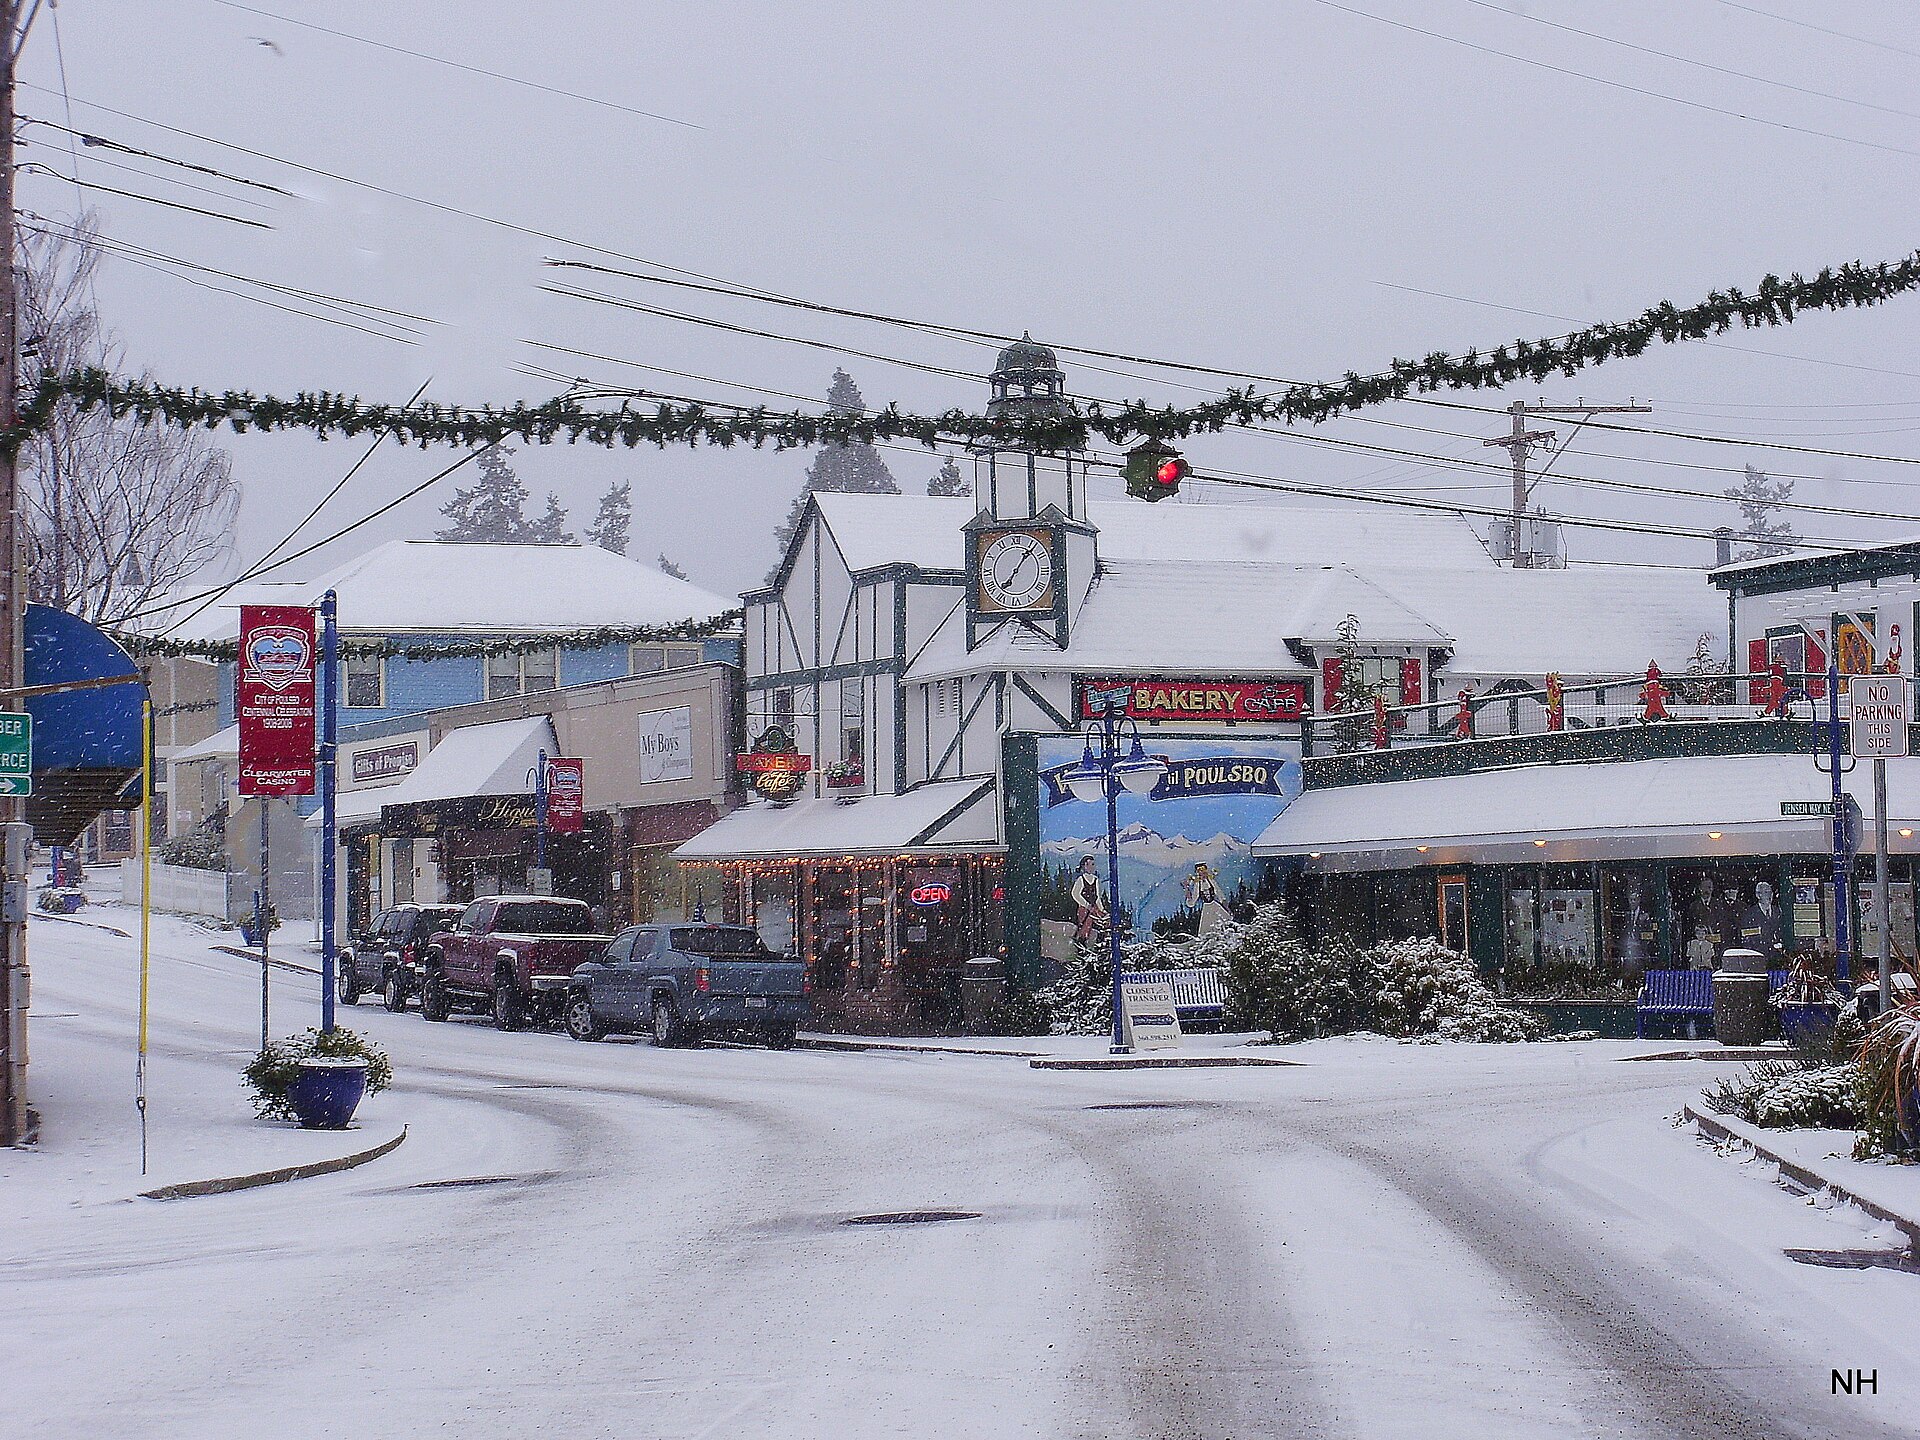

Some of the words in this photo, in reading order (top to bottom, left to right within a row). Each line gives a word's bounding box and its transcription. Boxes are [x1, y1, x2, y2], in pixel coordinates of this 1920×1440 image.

[1135, 689, 1241, 710] BAKERY
[1868, 687, 1889, 701] NO
[1855, 705, 1902, 720] PARKING
[1867, 723, 1891, 734] THIS
[1867, 737, 1892, 749] SIDE
[0, 753, 28, 768] RCE
[242, 769, 312, 778] CLEARWATER
[1184, 766, 1268, 788] POULSBO
[1783, 803, 1808, 814] JENSEN
[911, 888, 949, 901] OPEN
